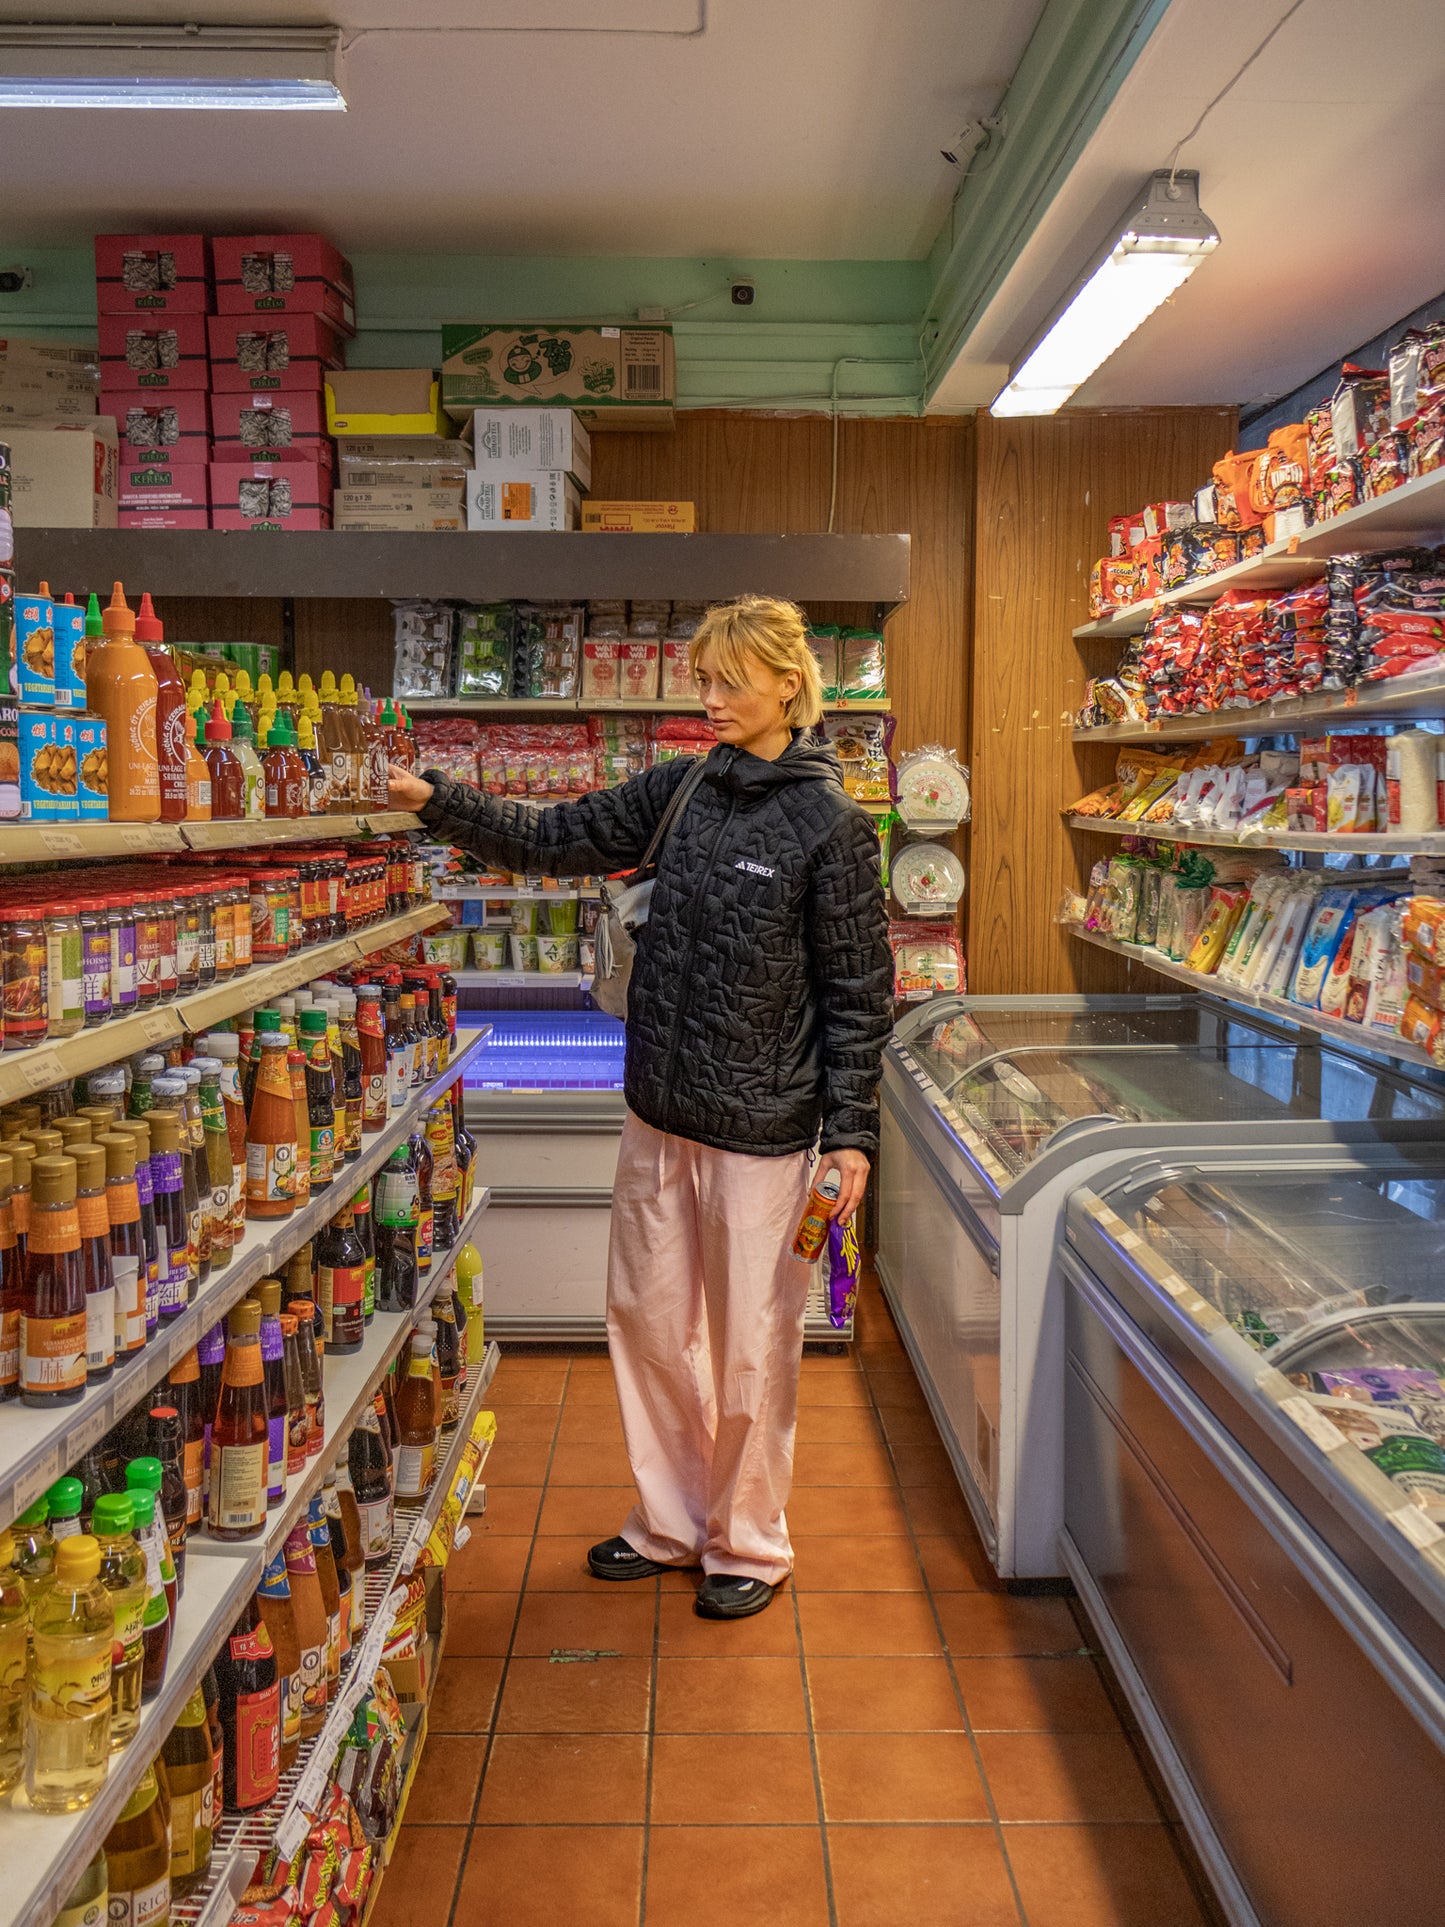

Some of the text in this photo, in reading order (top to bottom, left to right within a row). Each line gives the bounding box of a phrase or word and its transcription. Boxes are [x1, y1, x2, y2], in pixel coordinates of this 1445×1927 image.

[133, 473, 170, 485] KEREM
[674, 644, 689, 652] WA
[595, 651, 613, 659] WAI
[629, 651, 647, 659] WAI
